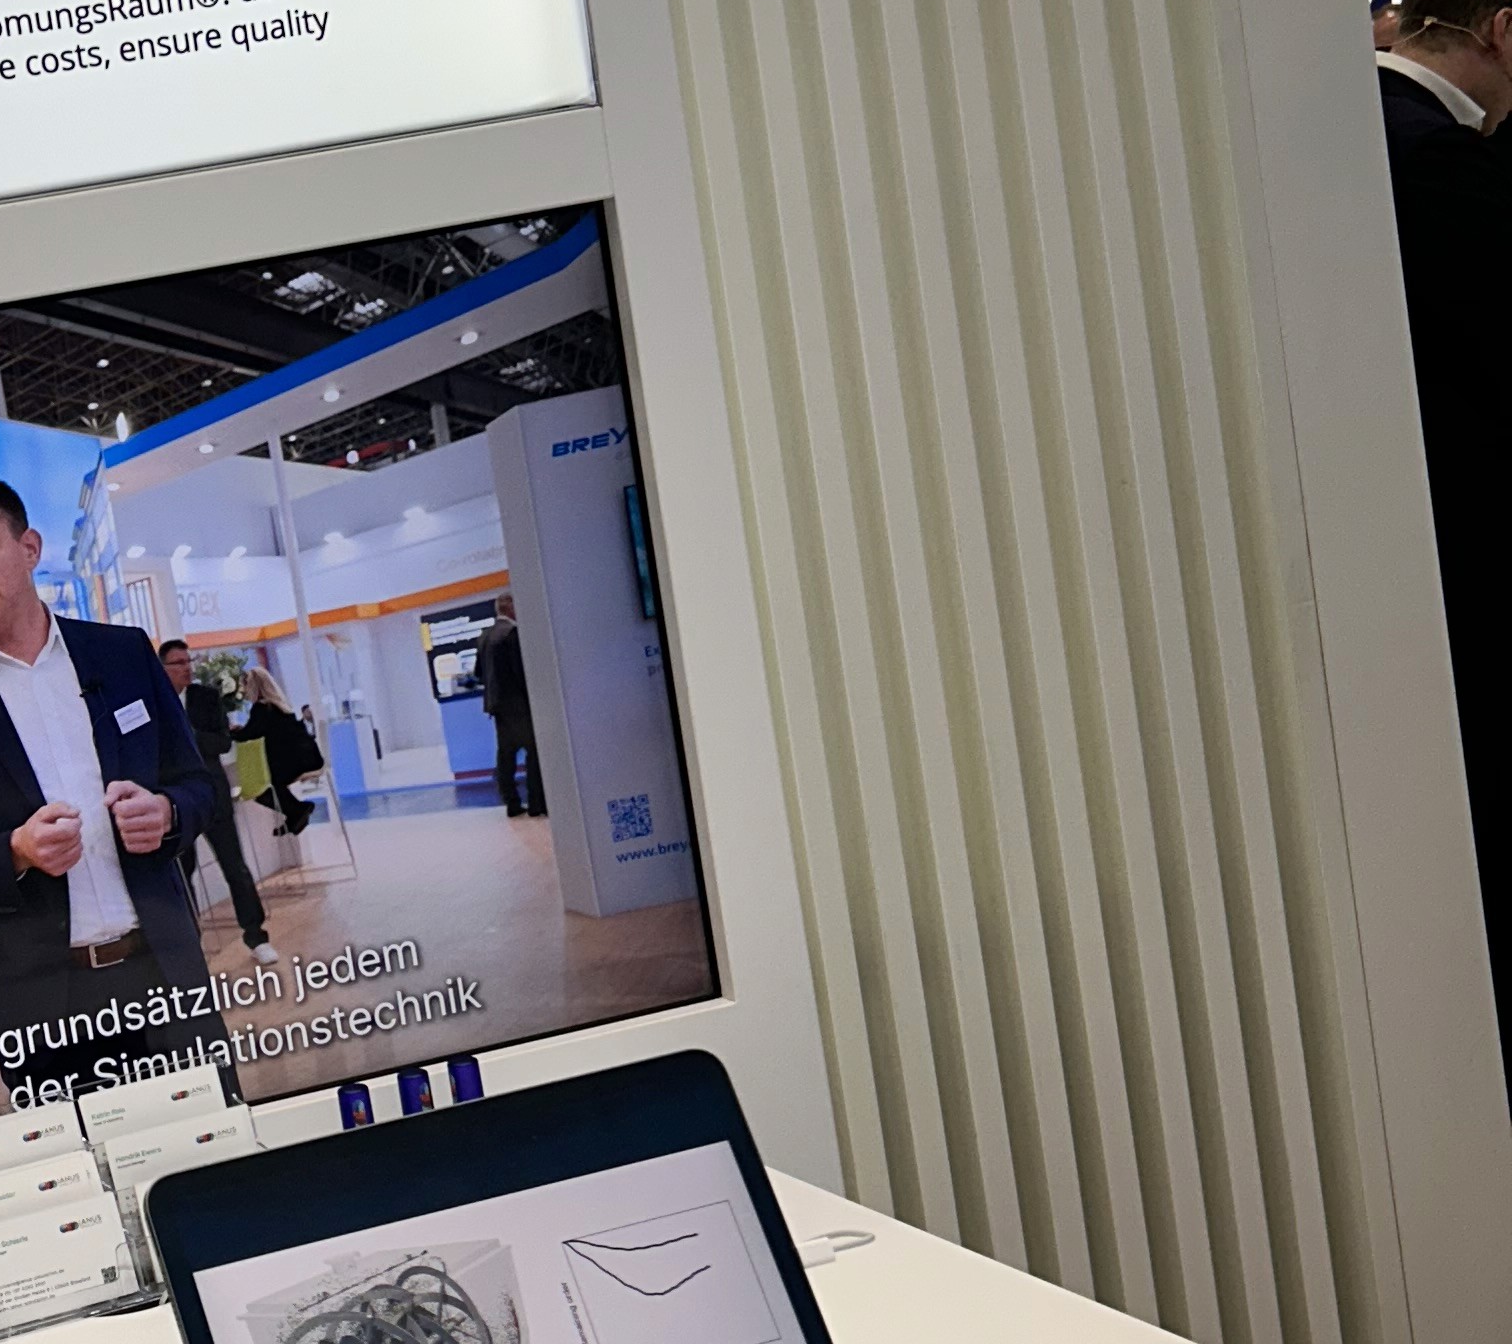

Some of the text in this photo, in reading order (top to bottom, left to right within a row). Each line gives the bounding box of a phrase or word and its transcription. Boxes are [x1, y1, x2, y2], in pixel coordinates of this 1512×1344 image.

[26, 45, 109, 75] costs,
[120, 29, 221, 61] ensure
[232, 10, 328, 51] quality
[552, 427, 628, 457] BREY
[293, 940, 418, 1003] jedem
[10, 1071, 79, 1115] der
[93, 976, 482, 1092] Simulationstechnik
